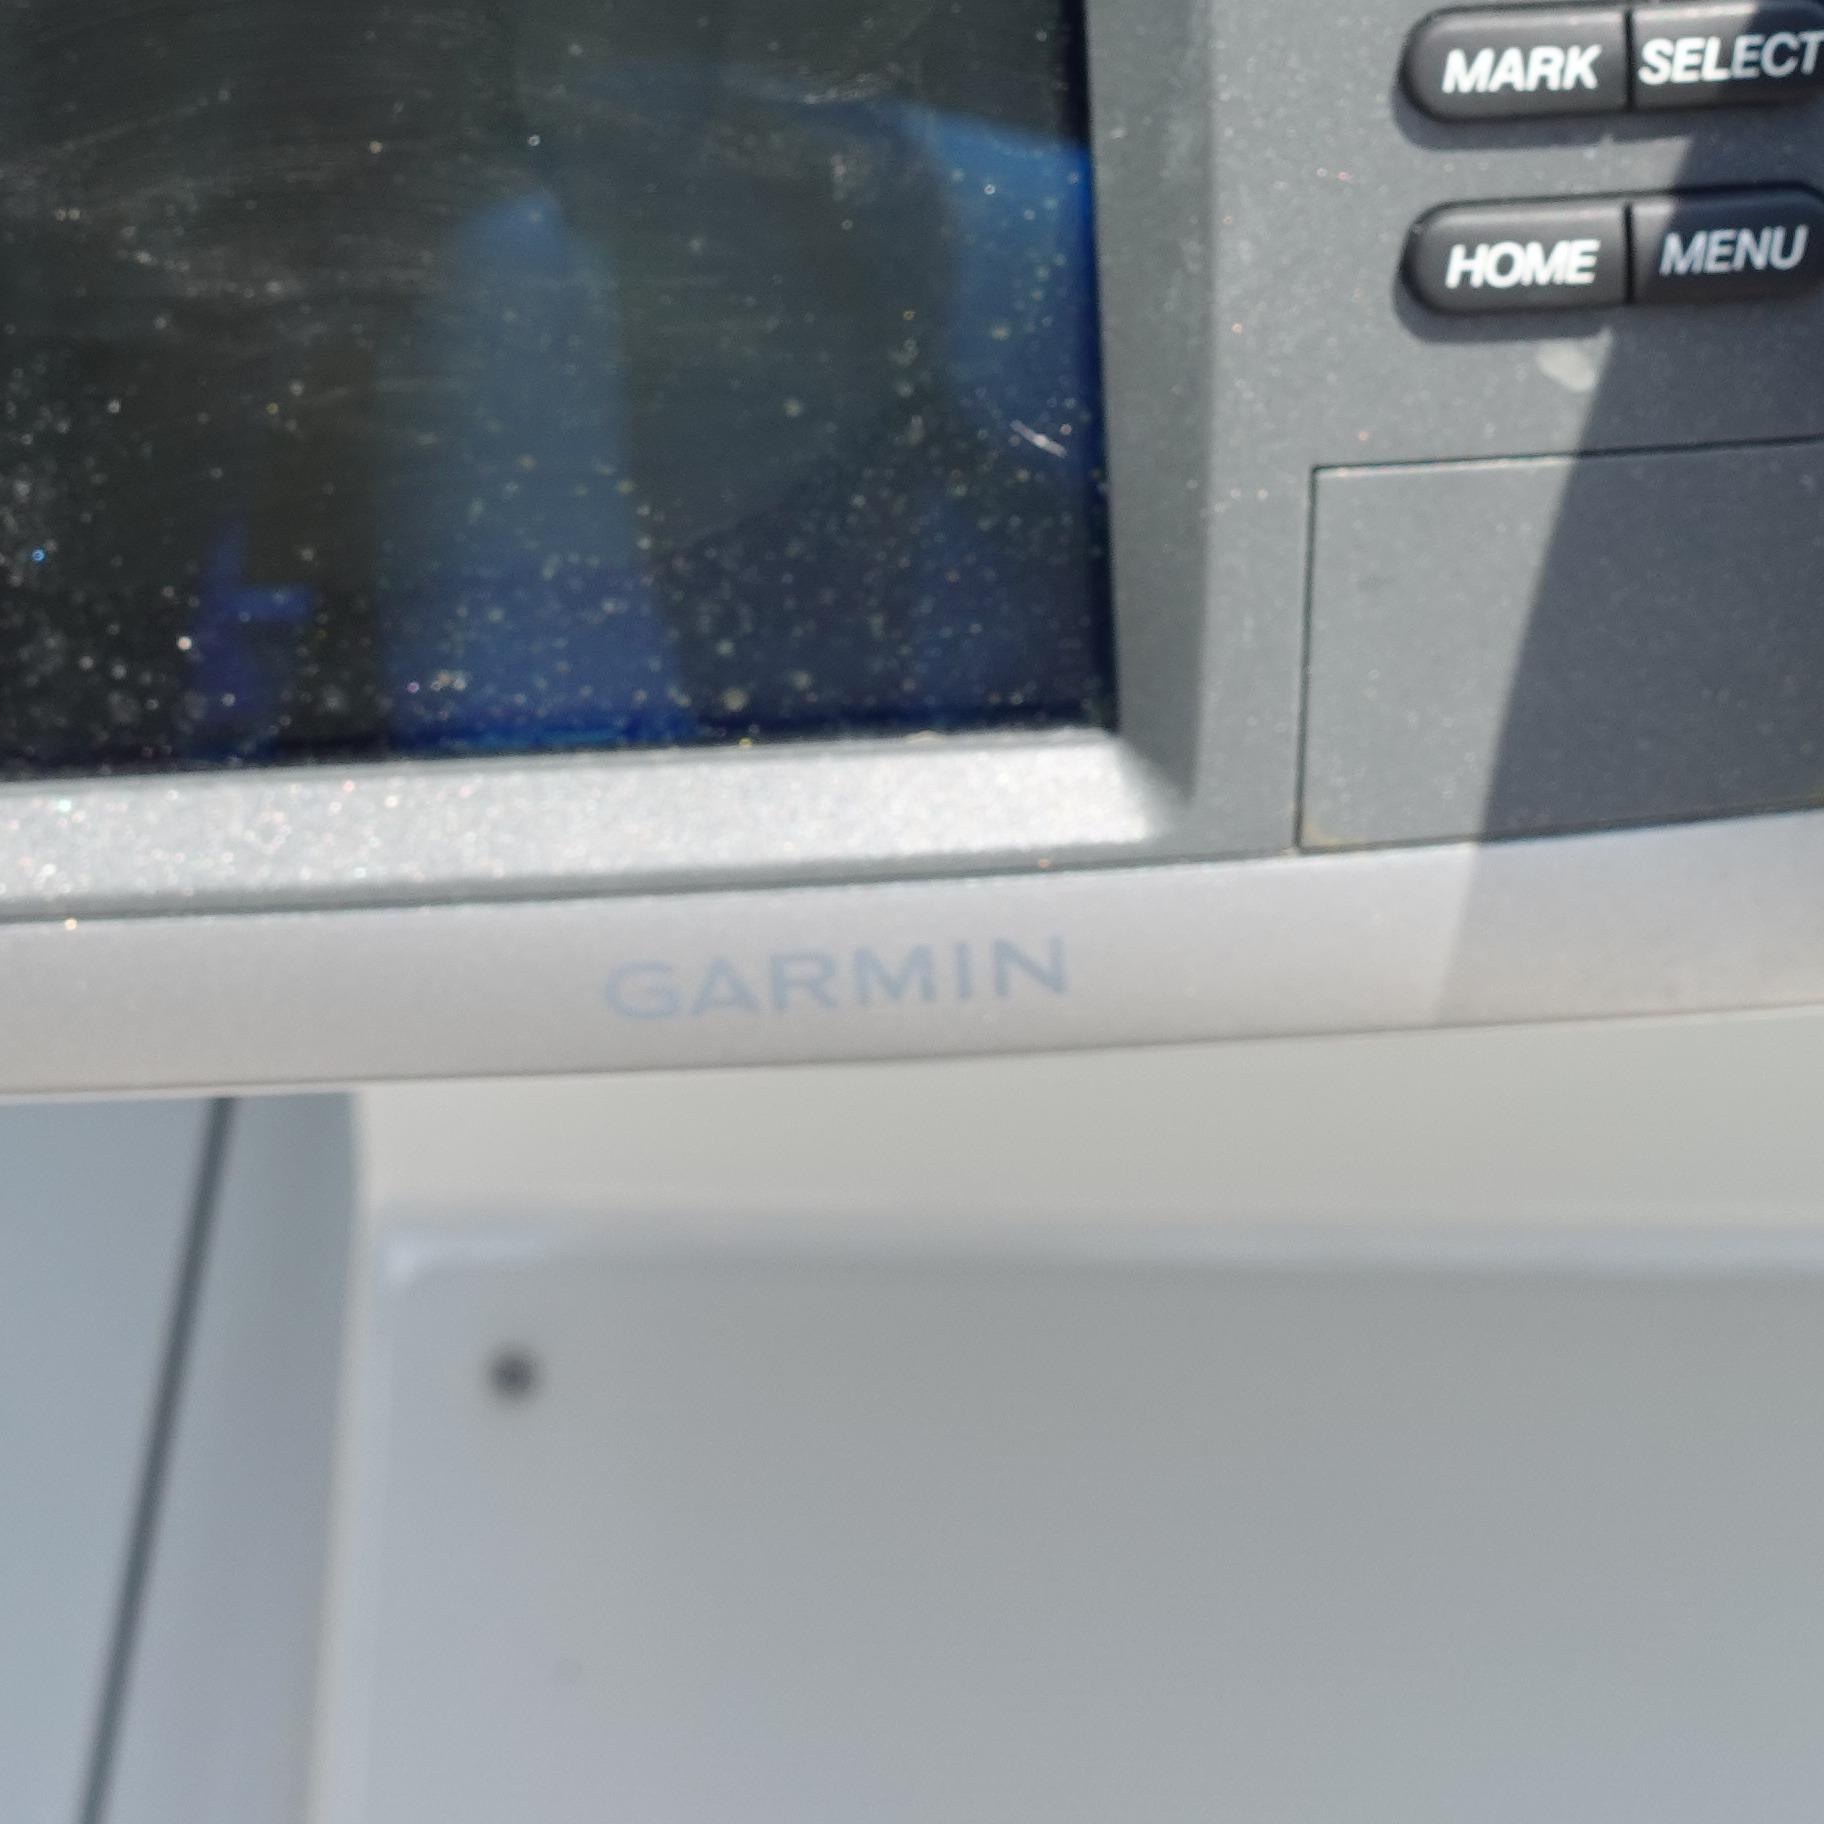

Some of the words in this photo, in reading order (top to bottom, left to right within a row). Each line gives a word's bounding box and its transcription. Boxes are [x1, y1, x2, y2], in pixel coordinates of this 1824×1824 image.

[1441, 43, 1603, 94] MARK
[1444, 238, 1601, 289] HOME
[1659, 225, 1810, 277] MENU
[602, 934, 1070, 1021] GARMIN
